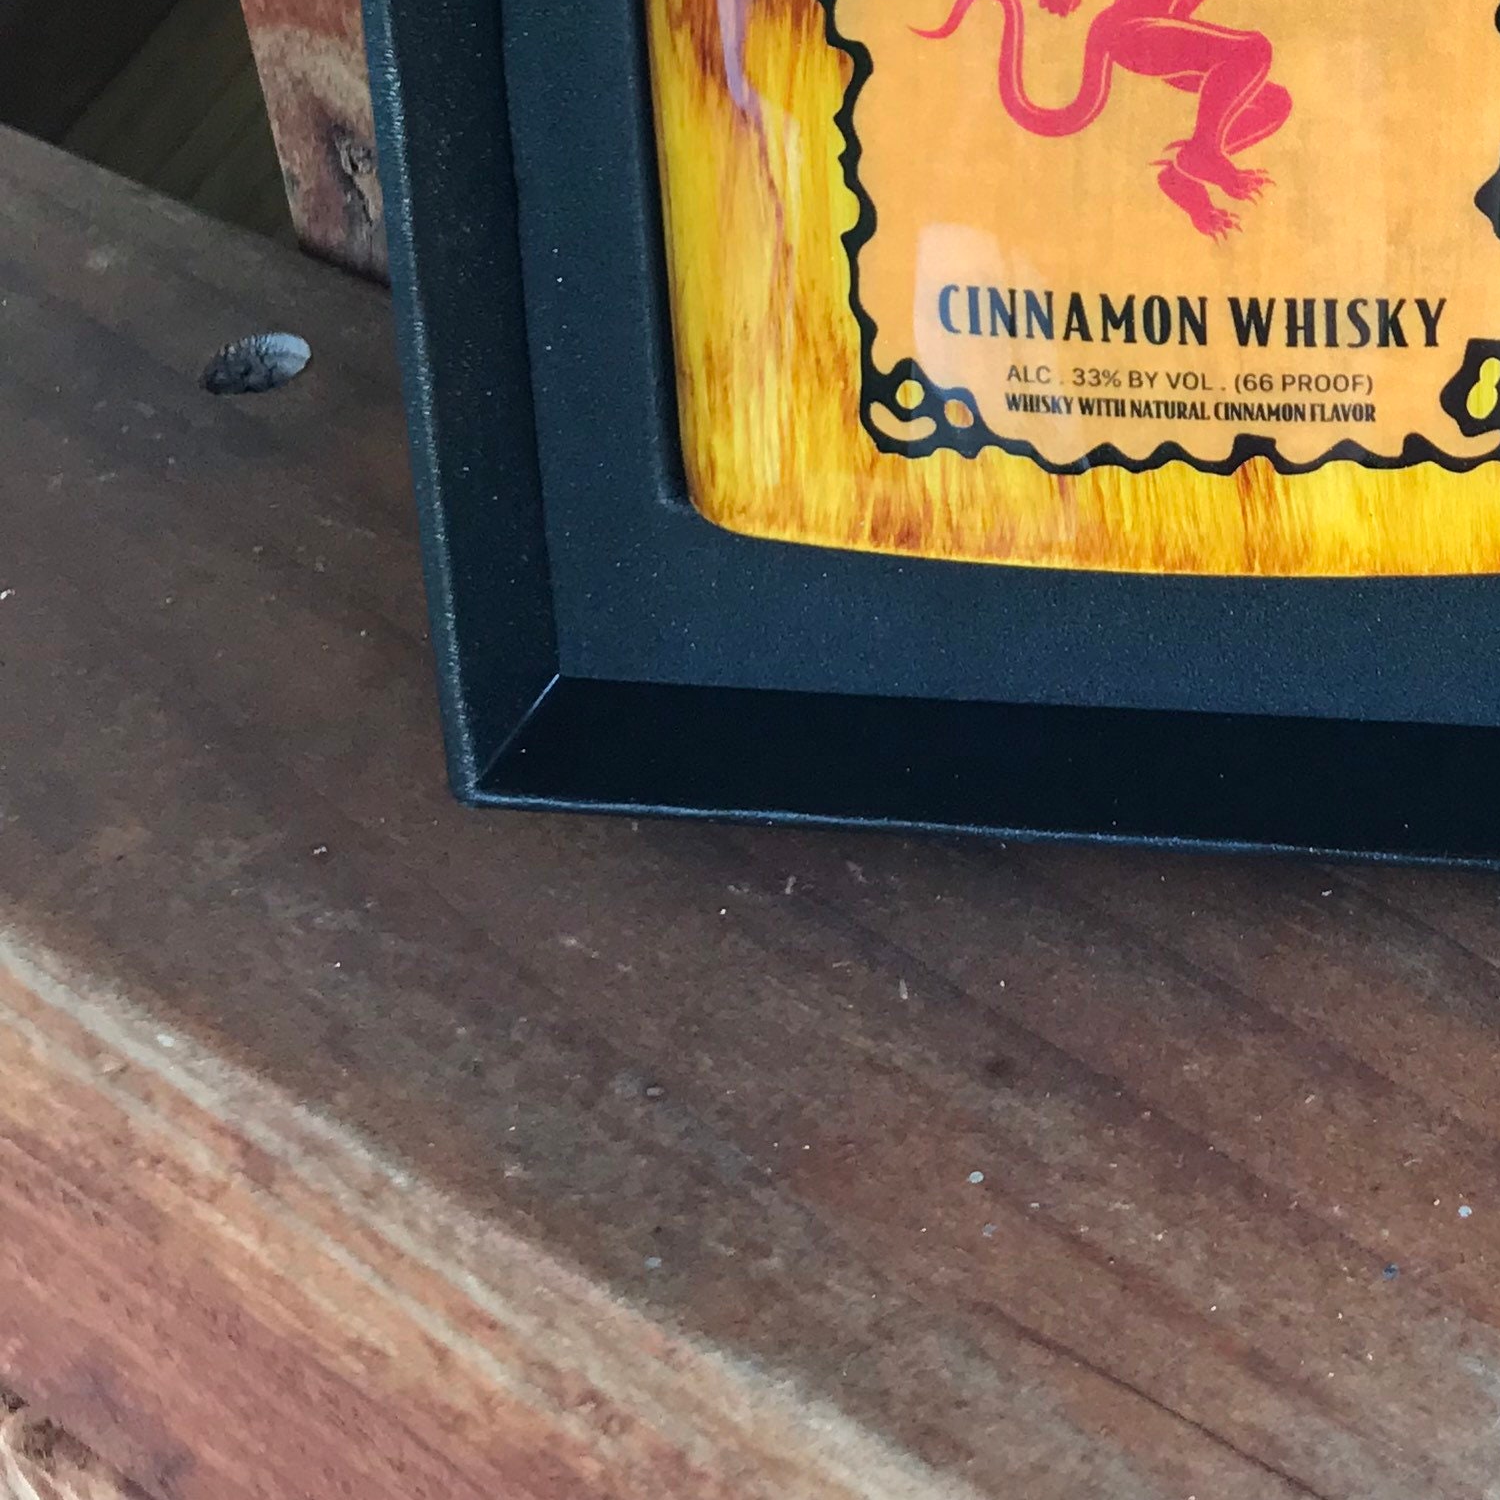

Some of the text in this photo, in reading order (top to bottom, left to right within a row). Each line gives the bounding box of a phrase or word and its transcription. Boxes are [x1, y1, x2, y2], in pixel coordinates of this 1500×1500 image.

[938, 284, 1447, 348] CINNAMON WHISKY
[1072, 367, 1122, 388] 33%
[1128, 370, 1158, 389] BY
[1234, 373, 1274, 394] (66
[1282, 373, 1373, 395] PROOF)
[1005, 392, 1376, 422] WHISKY WITH NATURAL CINNAMON FLAVOR
